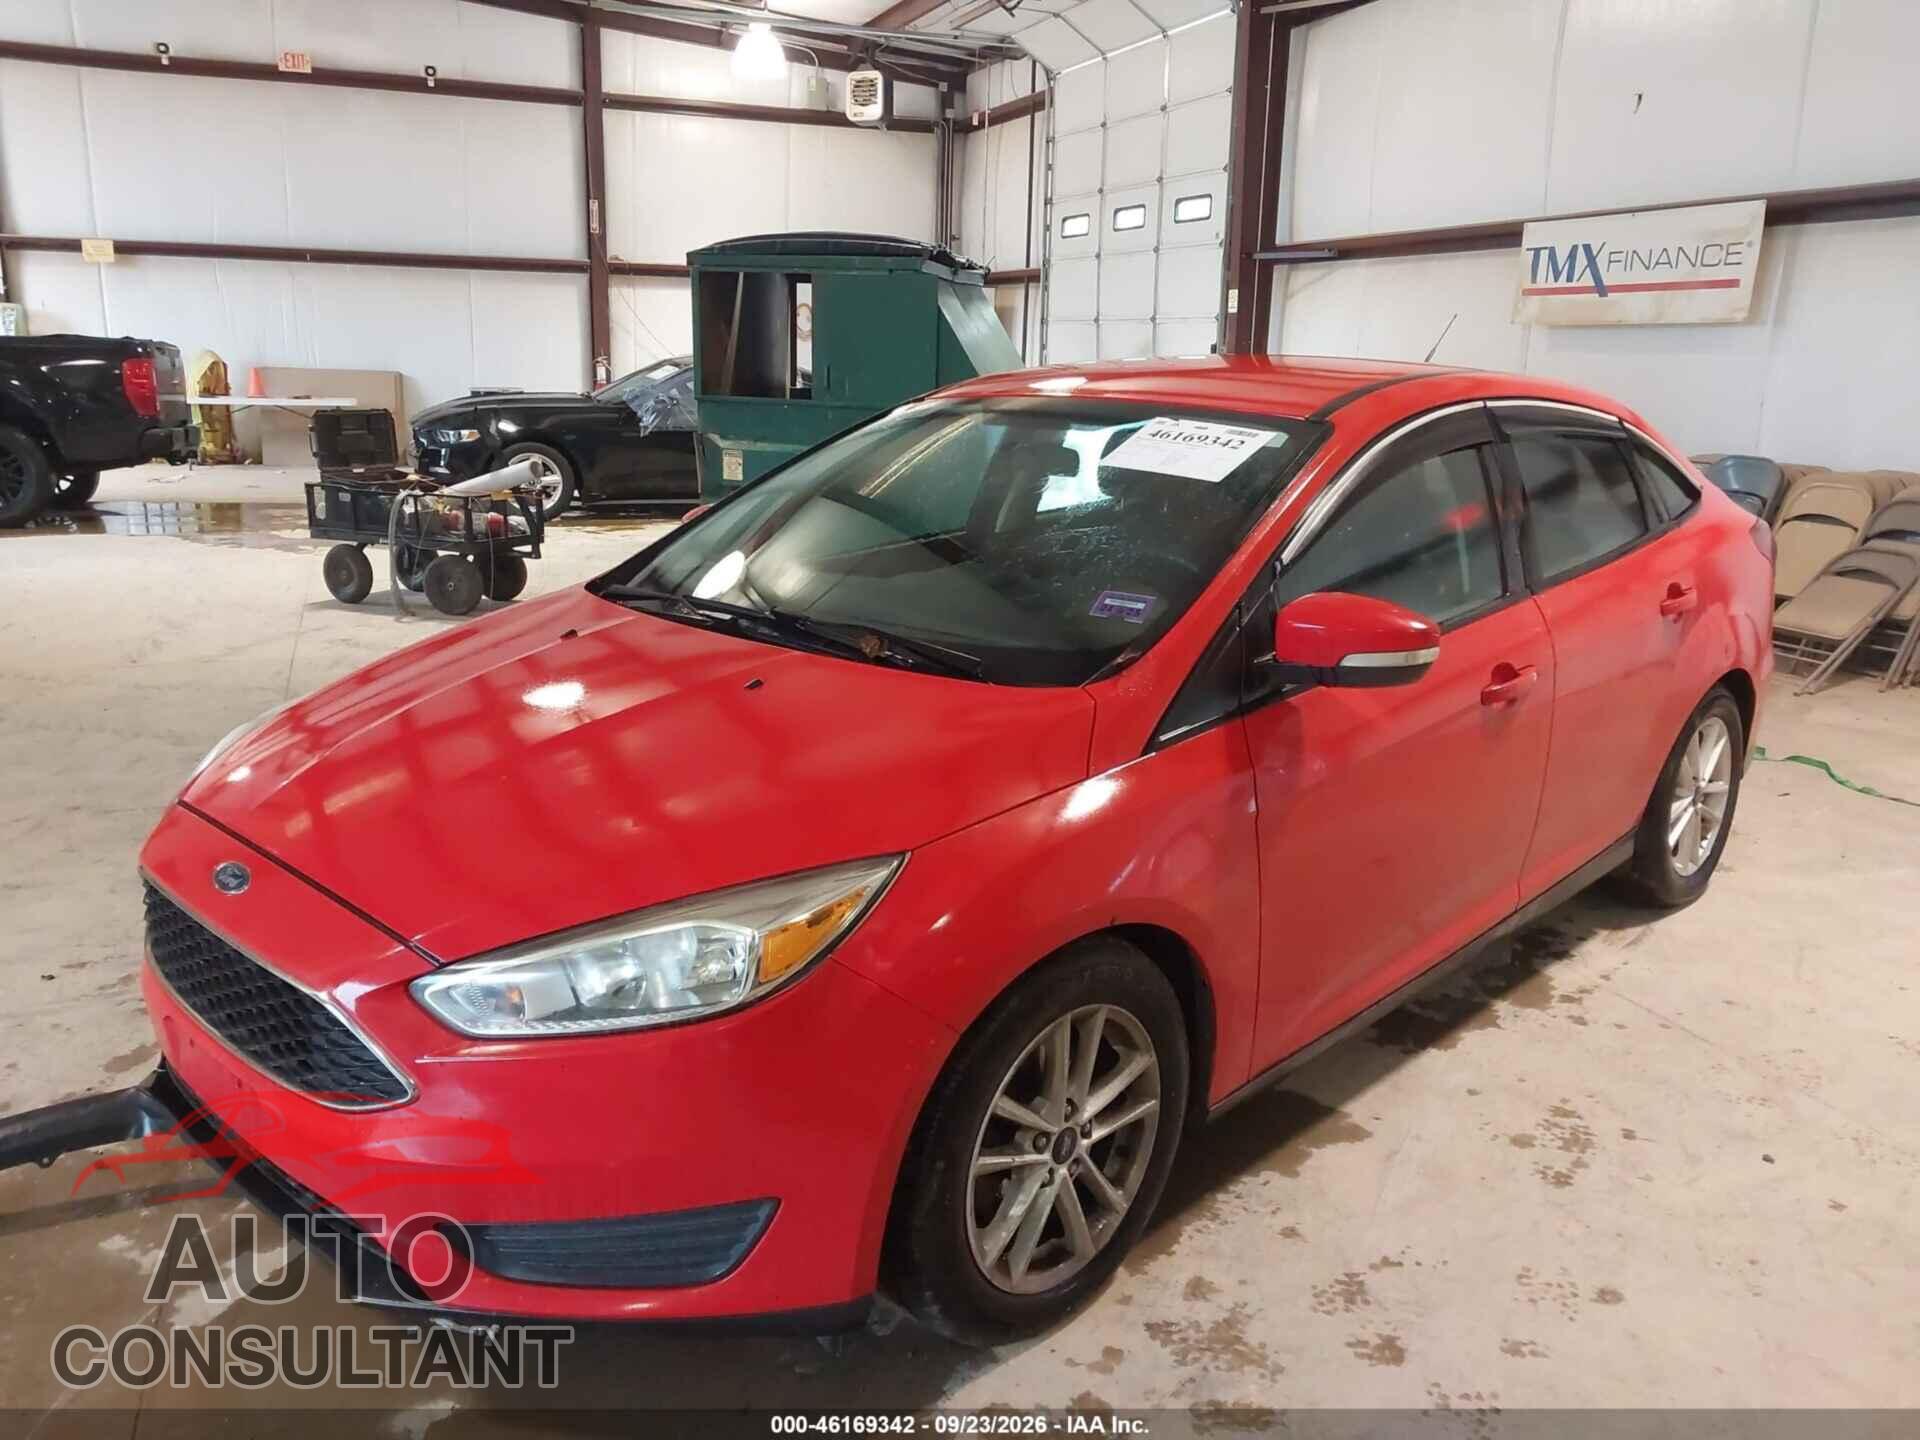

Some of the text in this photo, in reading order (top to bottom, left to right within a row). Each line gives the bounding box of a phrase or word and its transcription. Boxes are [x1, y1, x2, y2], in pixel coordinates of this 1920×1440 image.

[1525, 241, 1745, 297] TMX FINANCE
[1149, 429, 1246, 450] 46169342
